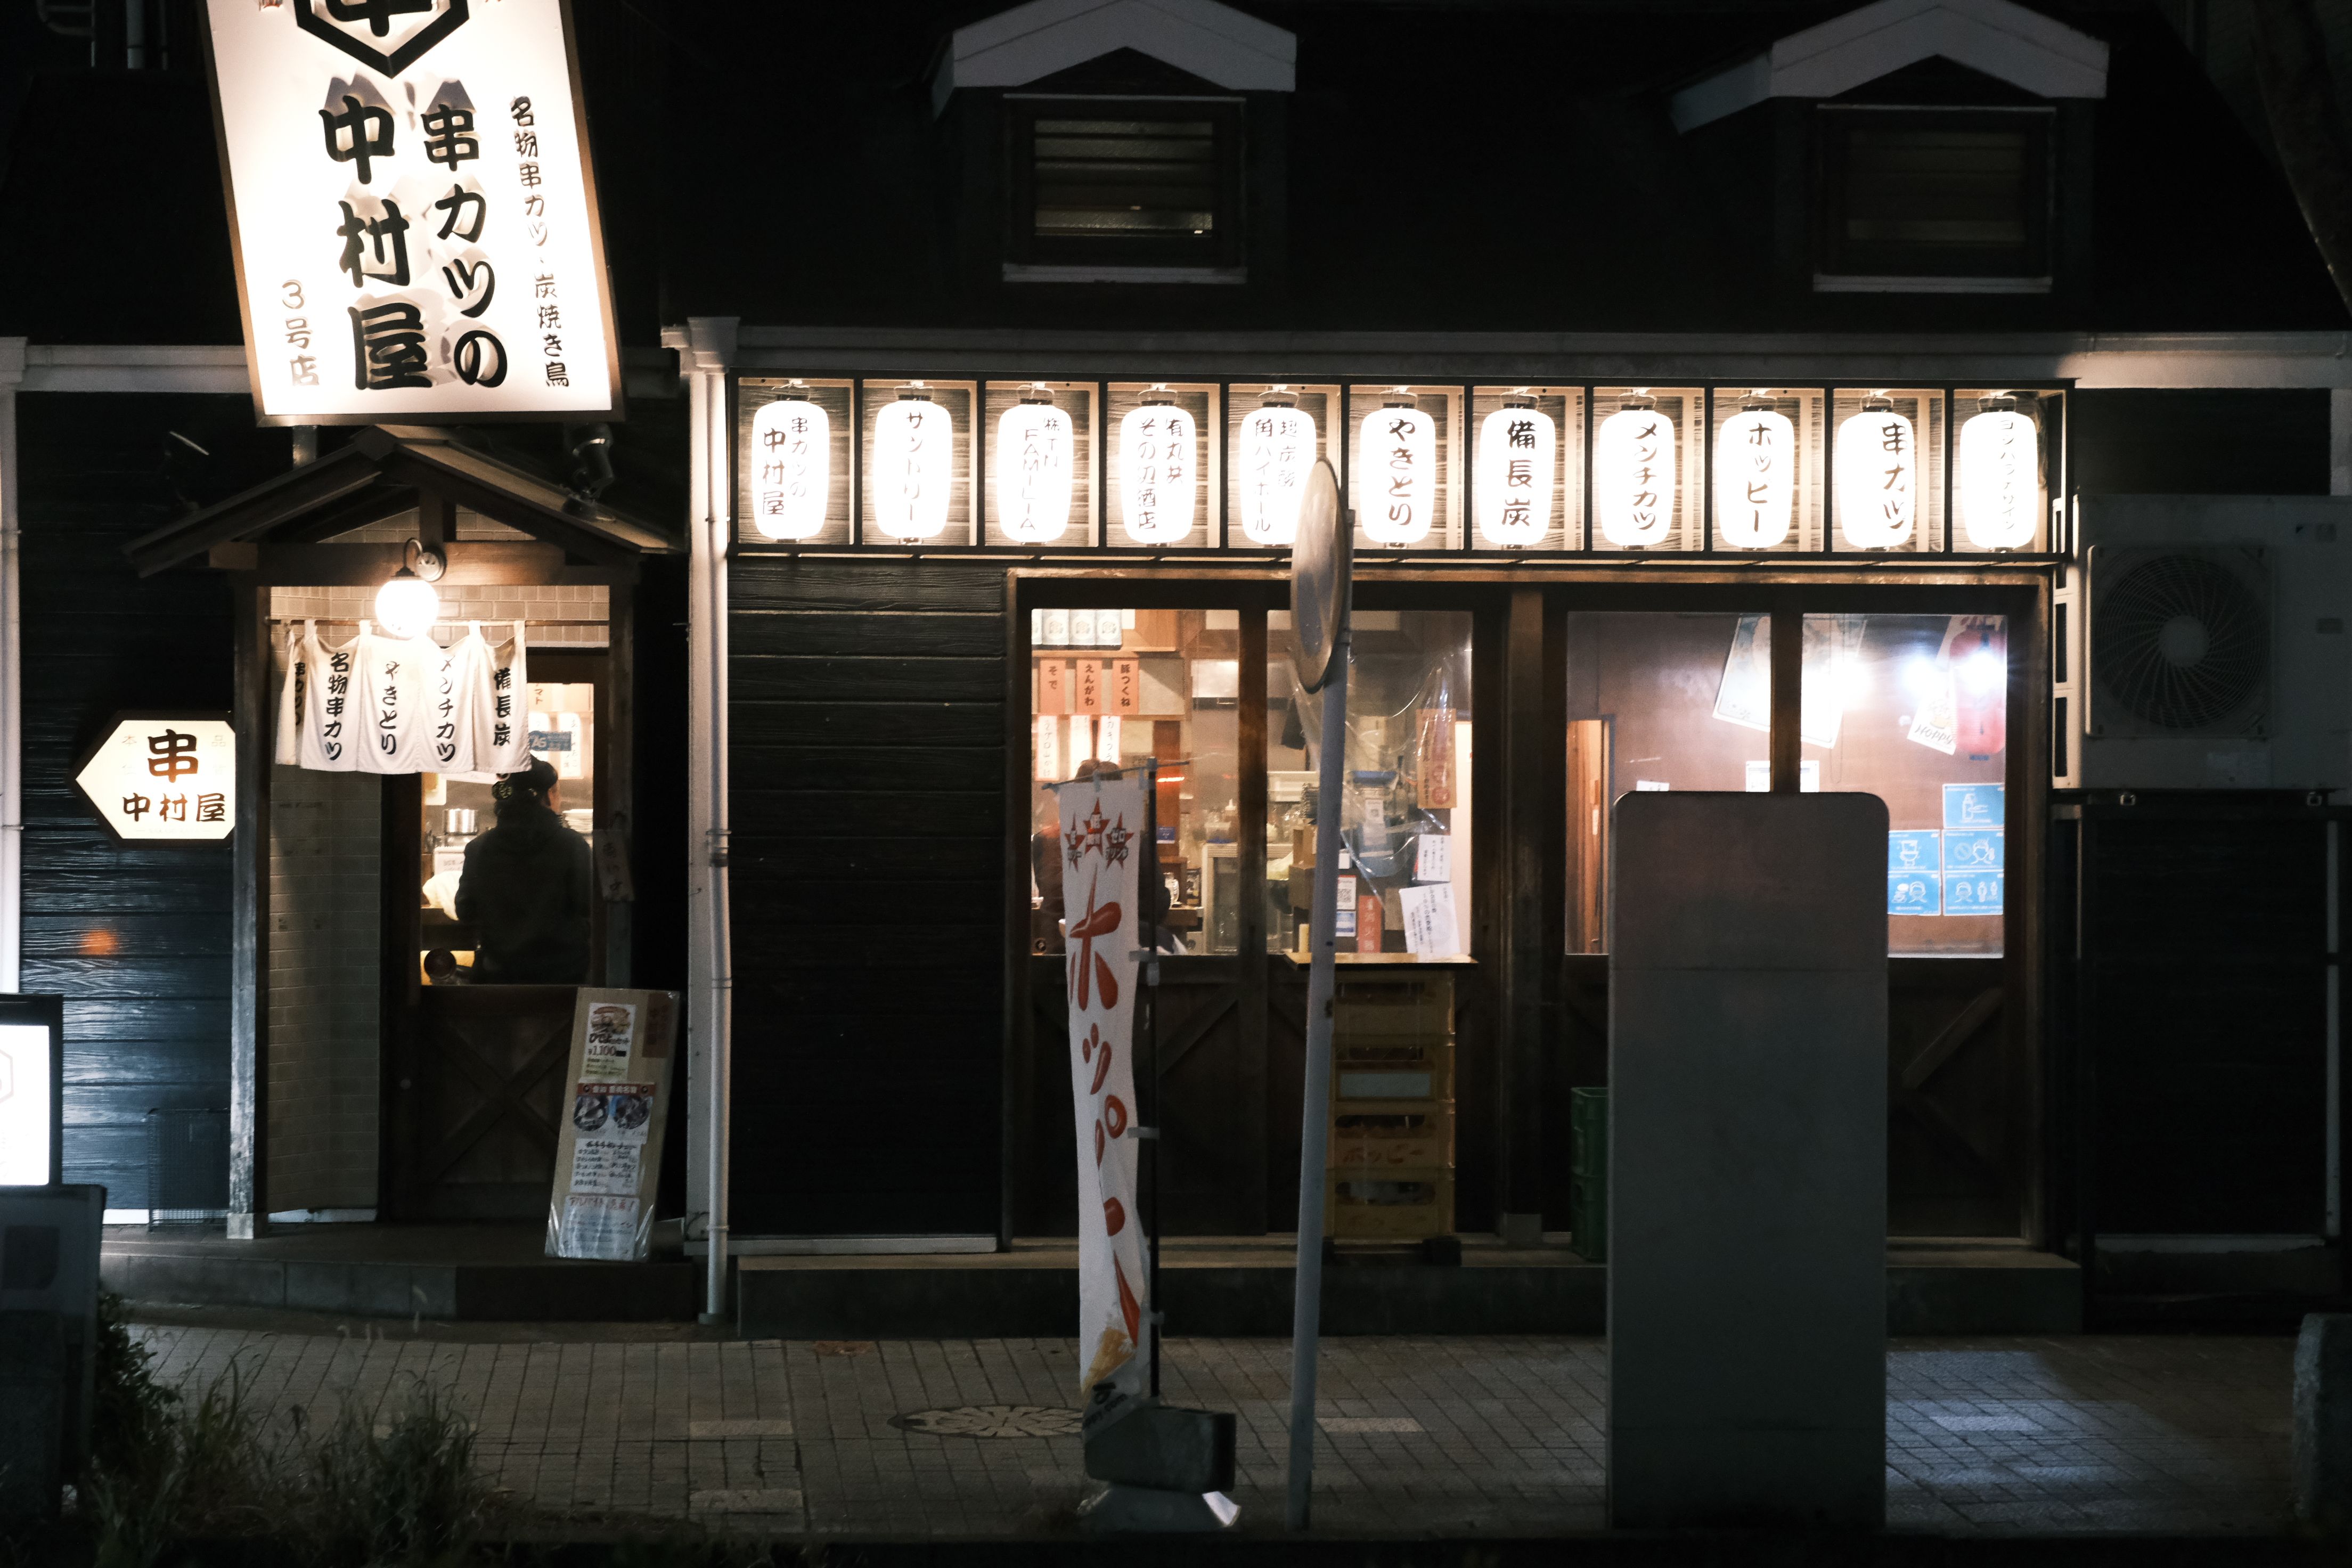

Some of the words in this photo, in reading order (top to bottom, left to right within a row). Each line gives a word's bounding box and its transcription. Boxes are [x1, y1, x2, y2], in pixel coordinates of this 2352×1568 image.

[319, 95, 433, 390] 中村屋
[420, 103, 508, 388] 串カツの
[281, 279, 320, 386] 3号店
[762, 427, 786, 516] 中村屋
[789, 416, 808, 497] 串カツの
[904, 411, 924, 521] サントリー
[1019, 428, 1040, 530] FAMILIA
[1388, 418, 1416, 526] やきとり
[1501, 419, 1536, 527] 備長炭
[1632, 422, 1657, 530] メンチカツ
[1881, 421, 1907, 530] 串カツ
[323, 651, 349, 761] 名物串カツ
[378, 660, 401, 755] やきとり
[435, 655, 456, 762] メンチカツ
[493, 667, 512, 747] 備長炭
[1084, 664, 1095, 707] えんがわ
[122, 792, 225, 822] 中村屋
[148, 729, 198, 783] 串
